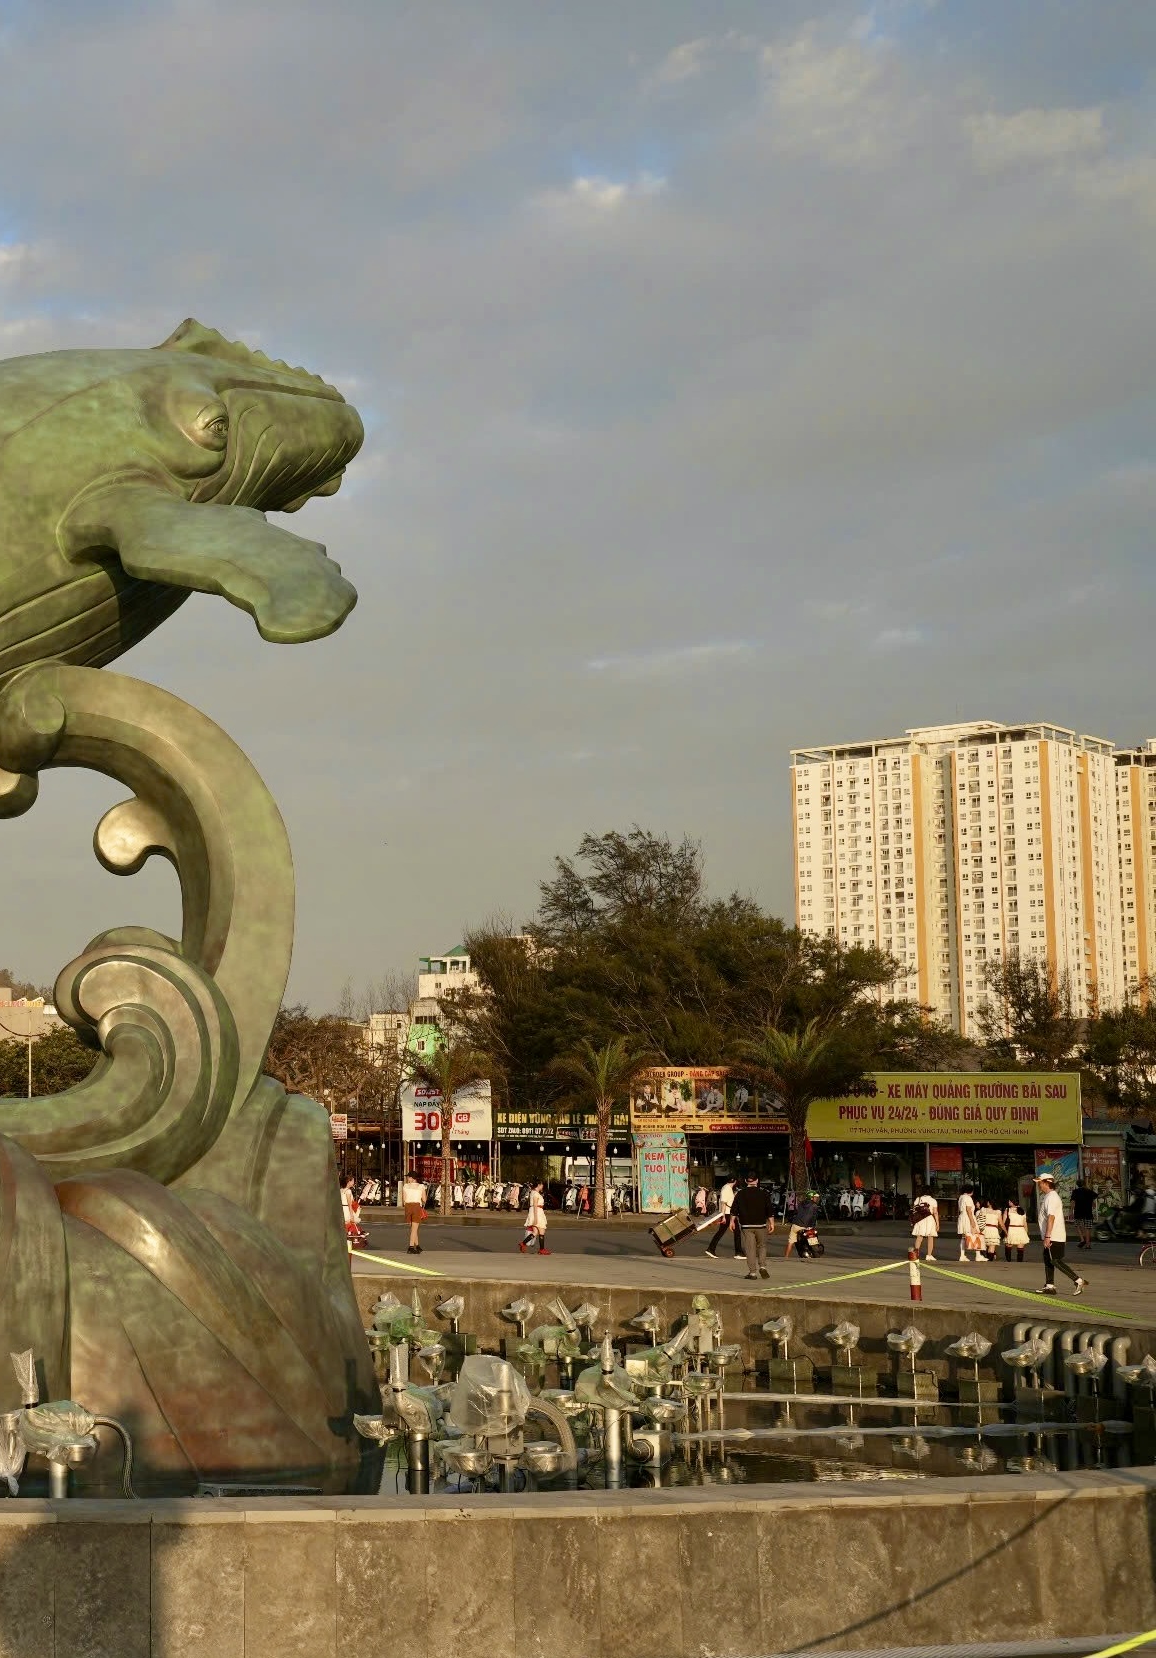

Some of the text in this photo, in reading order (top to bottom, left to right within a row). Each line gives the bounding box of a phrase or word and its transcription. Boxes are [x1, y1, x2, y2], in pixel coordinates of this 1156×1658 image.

[887, 1084, 901, 1098] XE
[905, 1081, 929, 1098] MÁY
[933, 1080, 971, 1100] QUẢNG
[974, 1080, 1018, 1099] TRƯỜNG
[1022, 1081, 1041, 1099] BÃI
[1045, 1084, 1067, 1099] SAU
[497, 1113, 507, 1124] XE
[508, 1111, 527, 1125] ĐIỆN
[839, 1105, 868, 1123] PHỤC
[871, 1105, 885, 1123] VỤ
[888, 1105, 918, 1121] 24/24
[929, 1103, 960, 1121] ĐÚNG
[963, 1104, 982, 1120] GIÁ
[986, 1106, 1007, 1123] QUY
[1010, 1106, 1039, 1124] ĐỊNH
